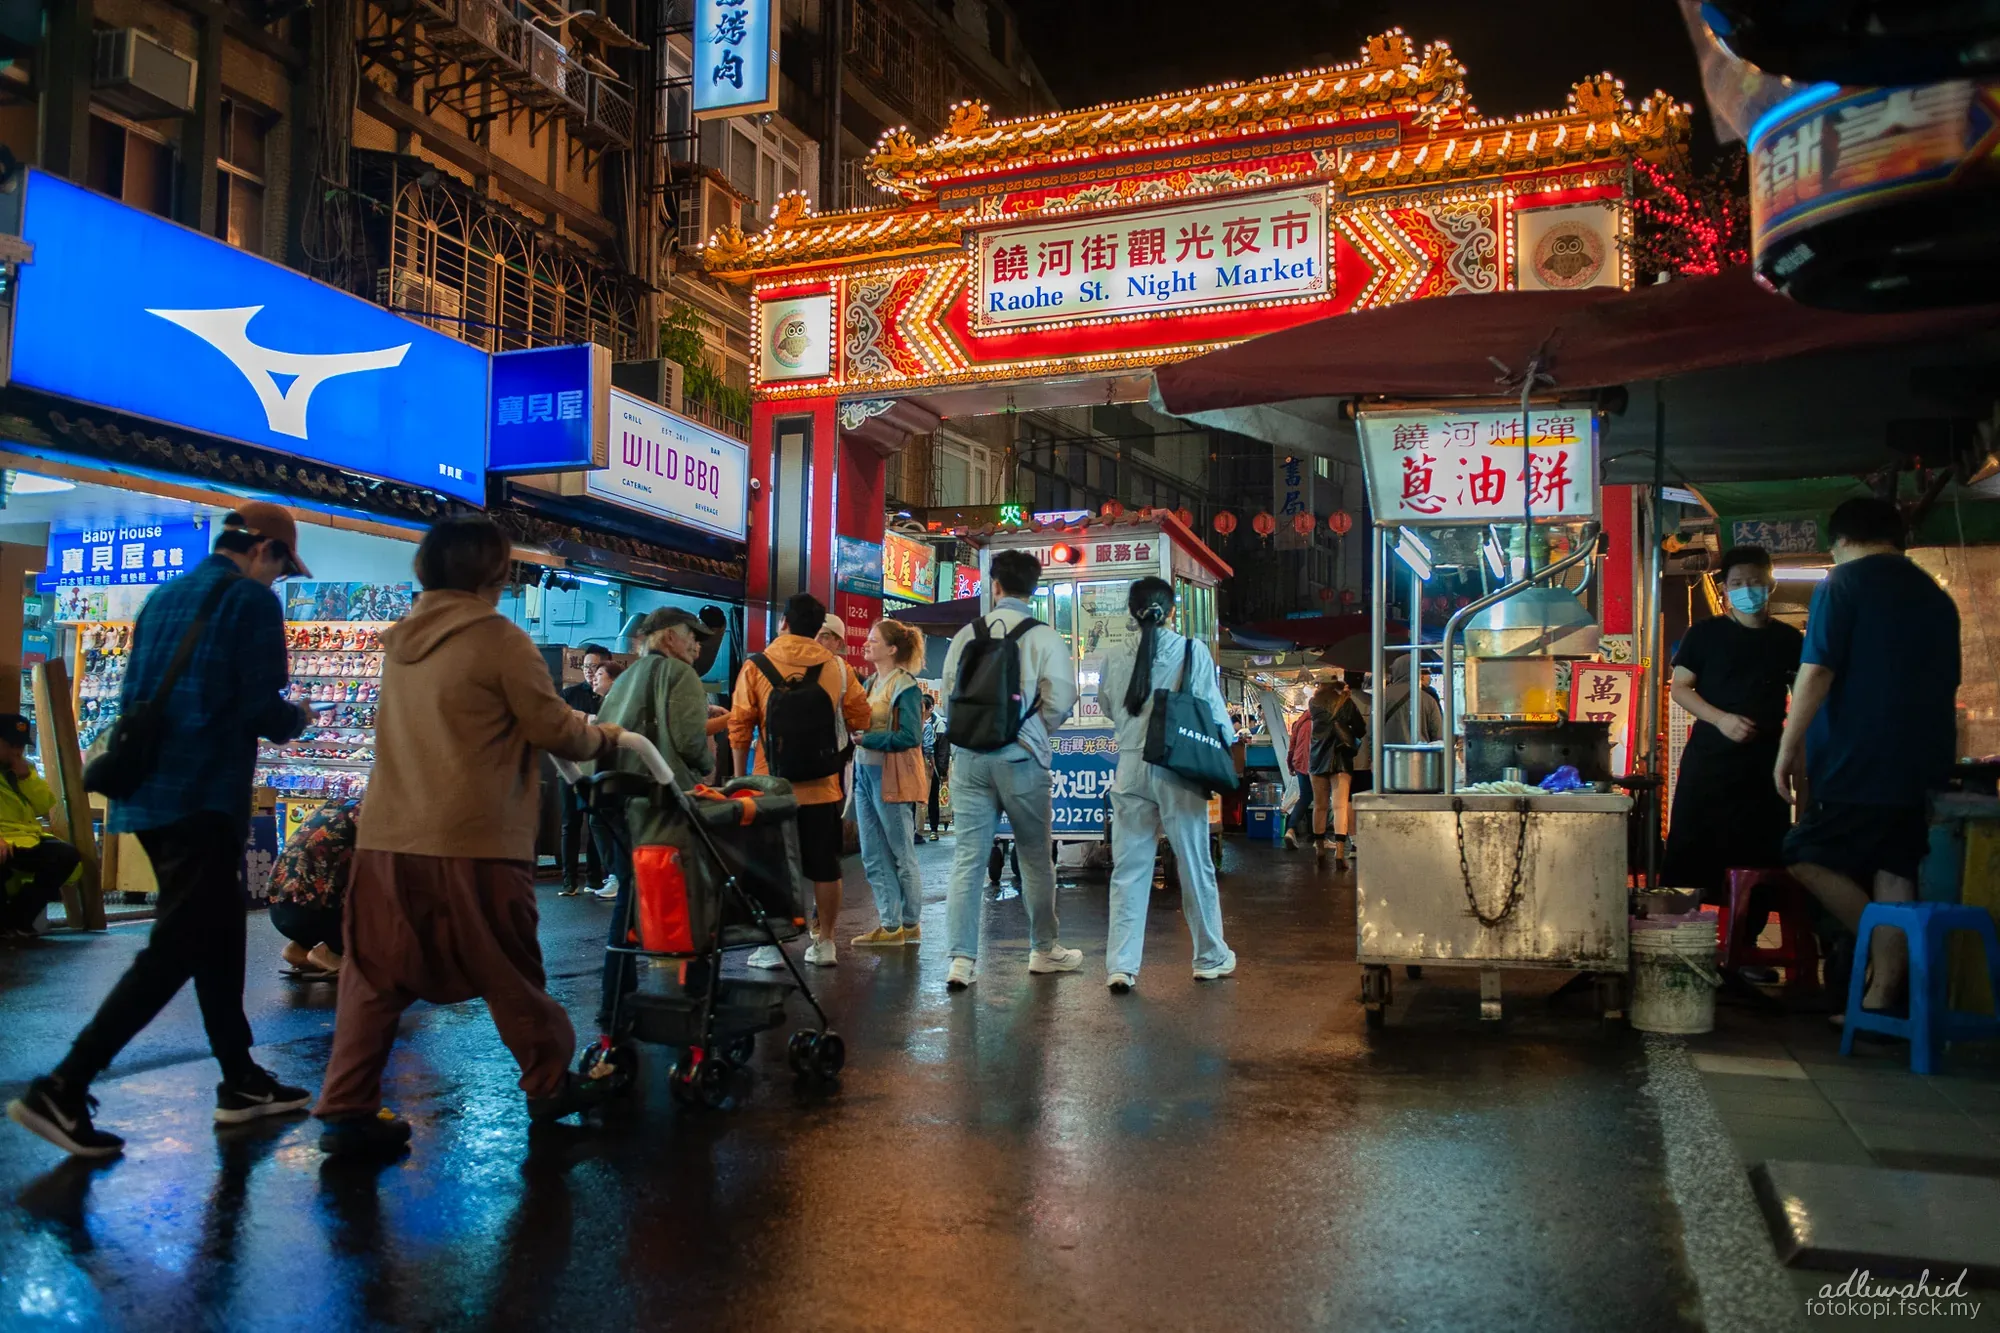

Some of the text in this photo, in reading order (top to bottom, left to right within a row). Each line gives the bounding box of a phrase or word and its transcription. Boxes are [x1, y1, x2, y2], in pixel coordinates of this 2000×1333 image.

[992, 210, 1312, 284] 饒河街觀光夜市
[989, 256, 1316, 314] Raohe St. Night Market
[498, 390, 584, 425] 寶貝屋
[623, 412, 642, 425] GRILL
[661, 427, 674, 437] EST.
[1393, 417, 1576, 450] 饒河炸彈
[710, 447, 721, 456] BAR
[623, 431, 719, 499] WILD BBQ
[622, 478, 652, 494] CATERING
[695, 502, 719, 516] BEVERAGE
[82, 526, 162, 544] Baby House
[62, 543, 145, 574] 寶貝屋
[1096, 543, 1151, 562] 服務台
[1178, 726, 1222, 749] MARHEN
